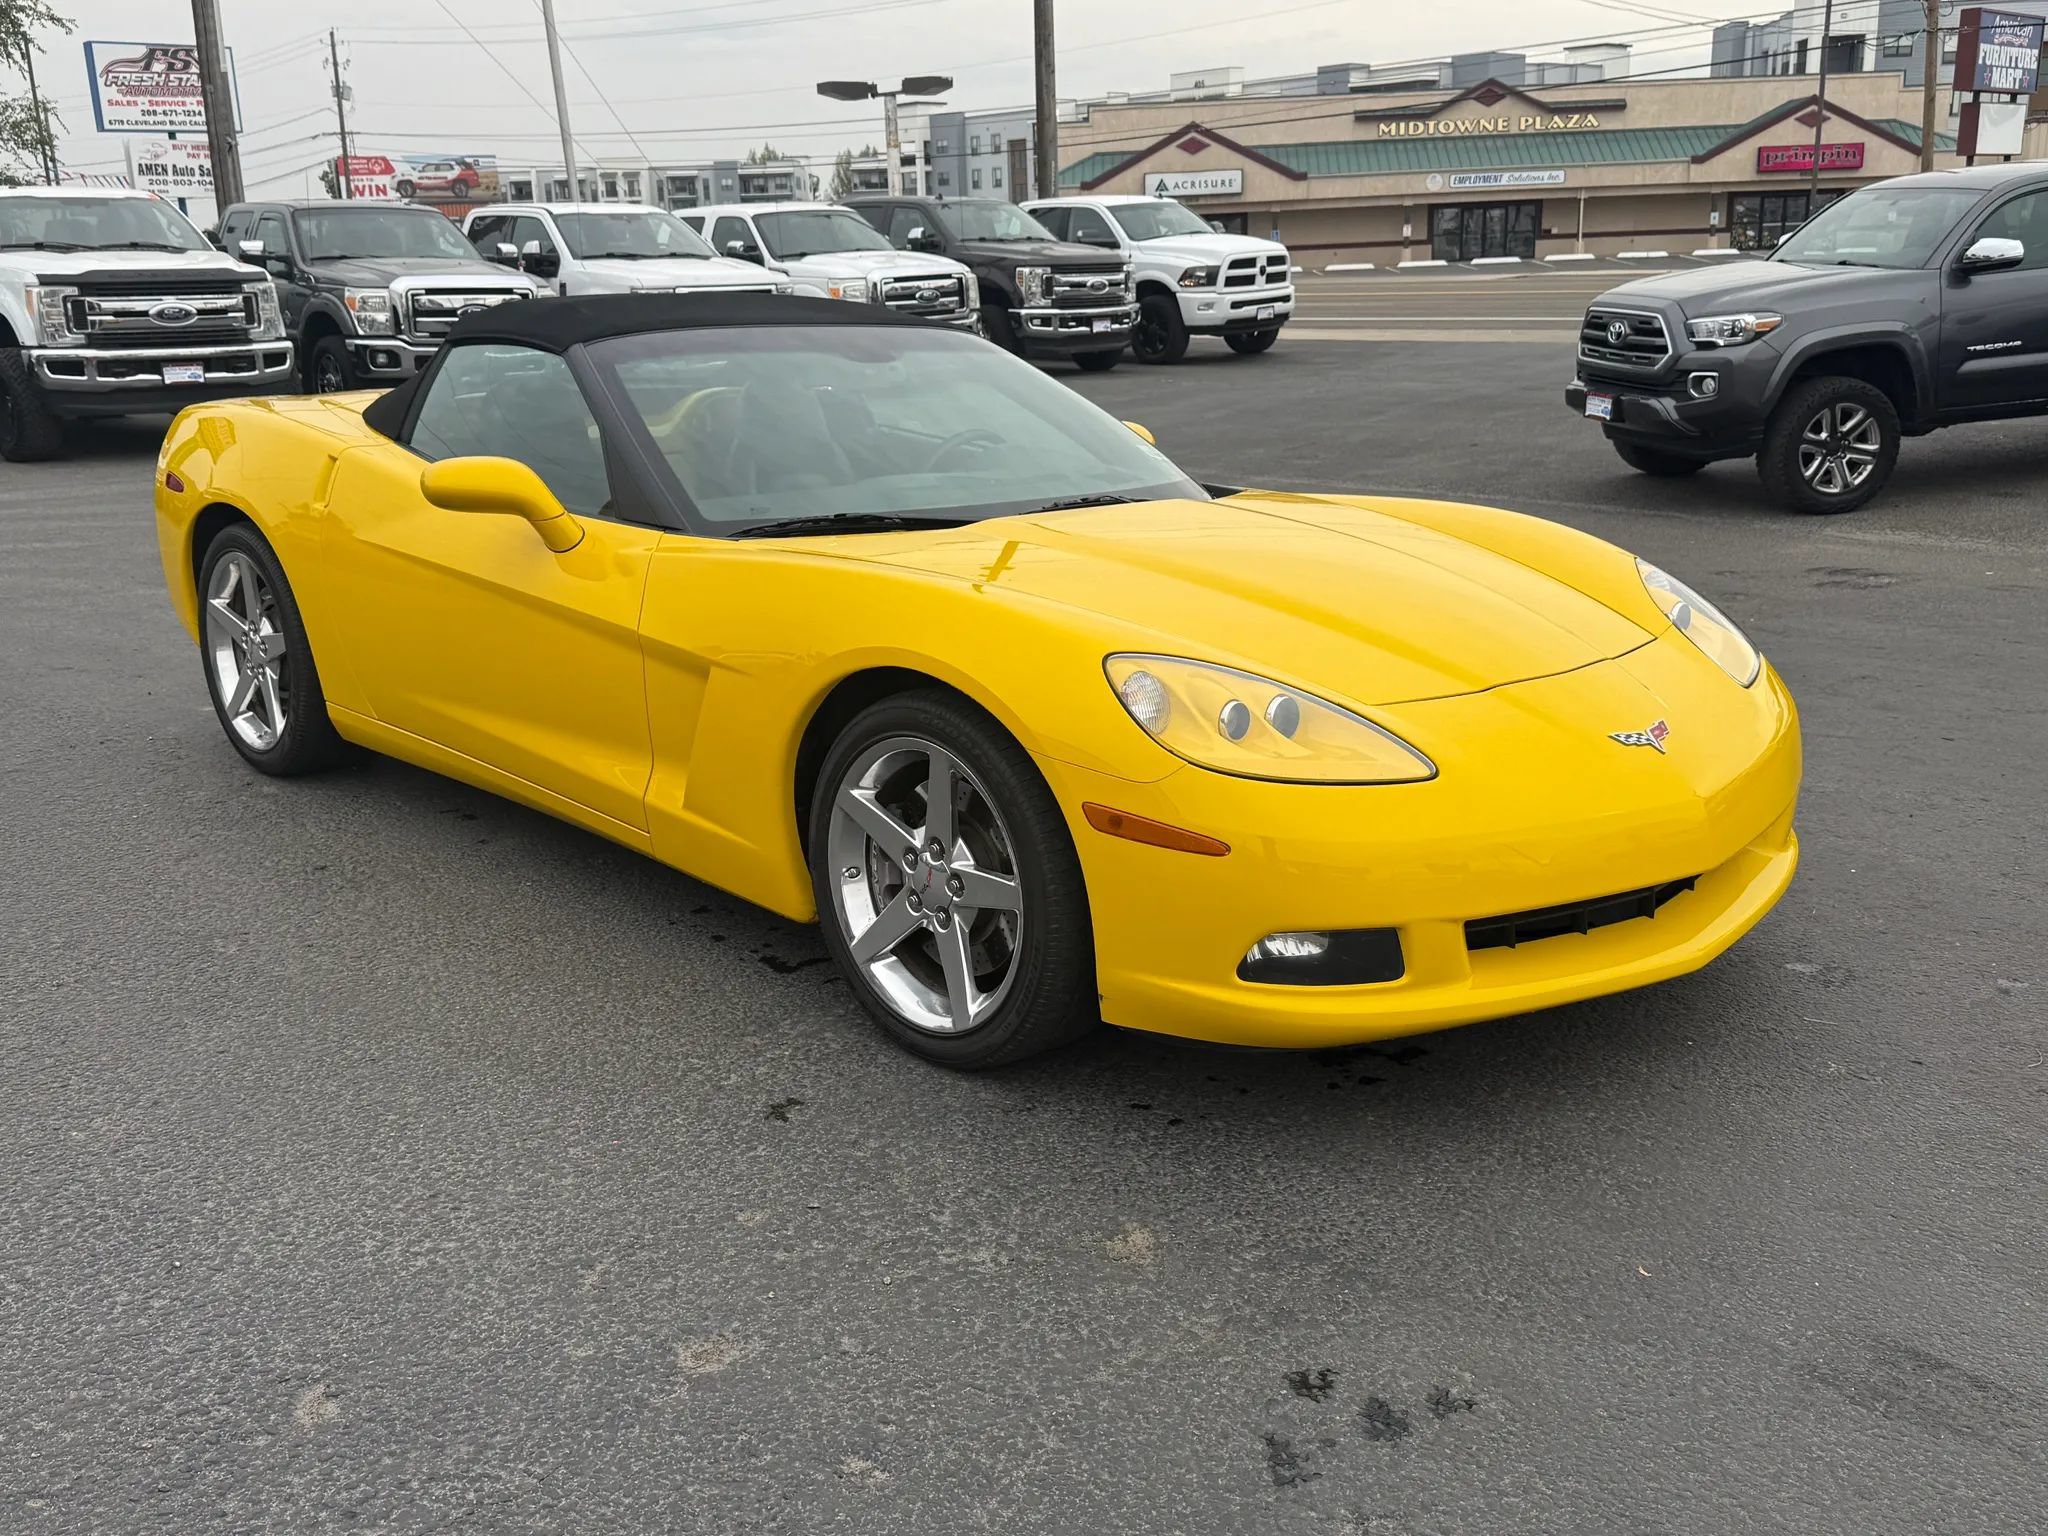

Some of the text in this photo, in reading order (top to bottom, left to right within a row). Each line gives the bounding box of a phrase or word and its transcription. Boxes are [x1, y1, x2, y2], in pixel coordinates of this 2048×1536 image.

[1990, 14, 2034, 39] American
[1978, 42, 2039, 70] FURNITURE
[106, 72, 202, 87] FRESH STA
[1990, 66, 2023, 90] MART
[123, 86, 202, 98] AUTOMOTIV
[108, 99, 139, 107] SALES
[148, 99, 187, 107] SERVICE
[141, 109, 202, 117] 208-671-1234
[126, 119, 168, 127] CLEVELAND
[1378, 113, 1600, 137] MIDTOWNE PLAZA
[186, 152, 202, 160] PAY
[138, 163, 169, 176] AMEN
[172, 164, 196, 177] Auto
[148, 178, 214, 187] 208-803-104
[1172, 179, 1234, 190] ACRISURE
[1453, 174, 1504, 185] EMPLOYMENT
[1506, 173, 1544, 184] Solutions
[351, 184, 388, 197] WIN
[1967, 341, 2022, 351] TACOMA
